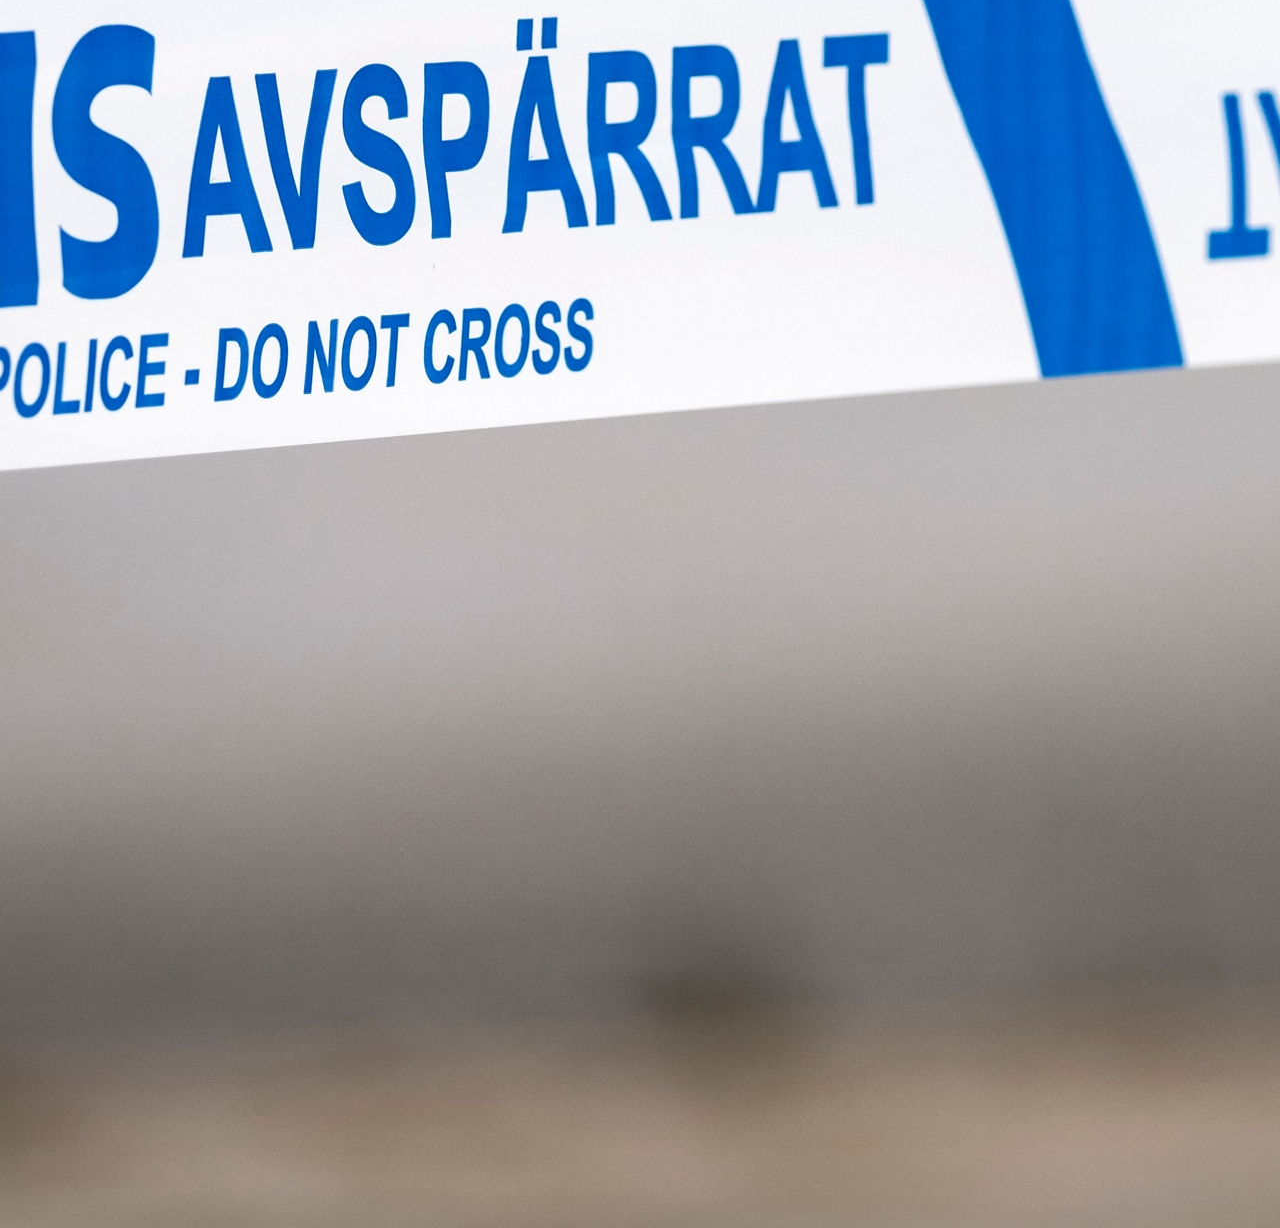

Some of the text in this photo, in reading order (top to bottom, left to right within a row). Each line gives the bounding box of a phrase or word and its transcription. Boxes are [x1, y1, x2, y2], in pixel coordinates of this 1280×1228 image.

[181, 16, 890, 259] AVSPÄRRAT
[183, 368, 201, 386] -
[213, 322, 289, 403] DO
[303, 308, 411, 395] NOT
[423, 297, 595, 385] CROSS
